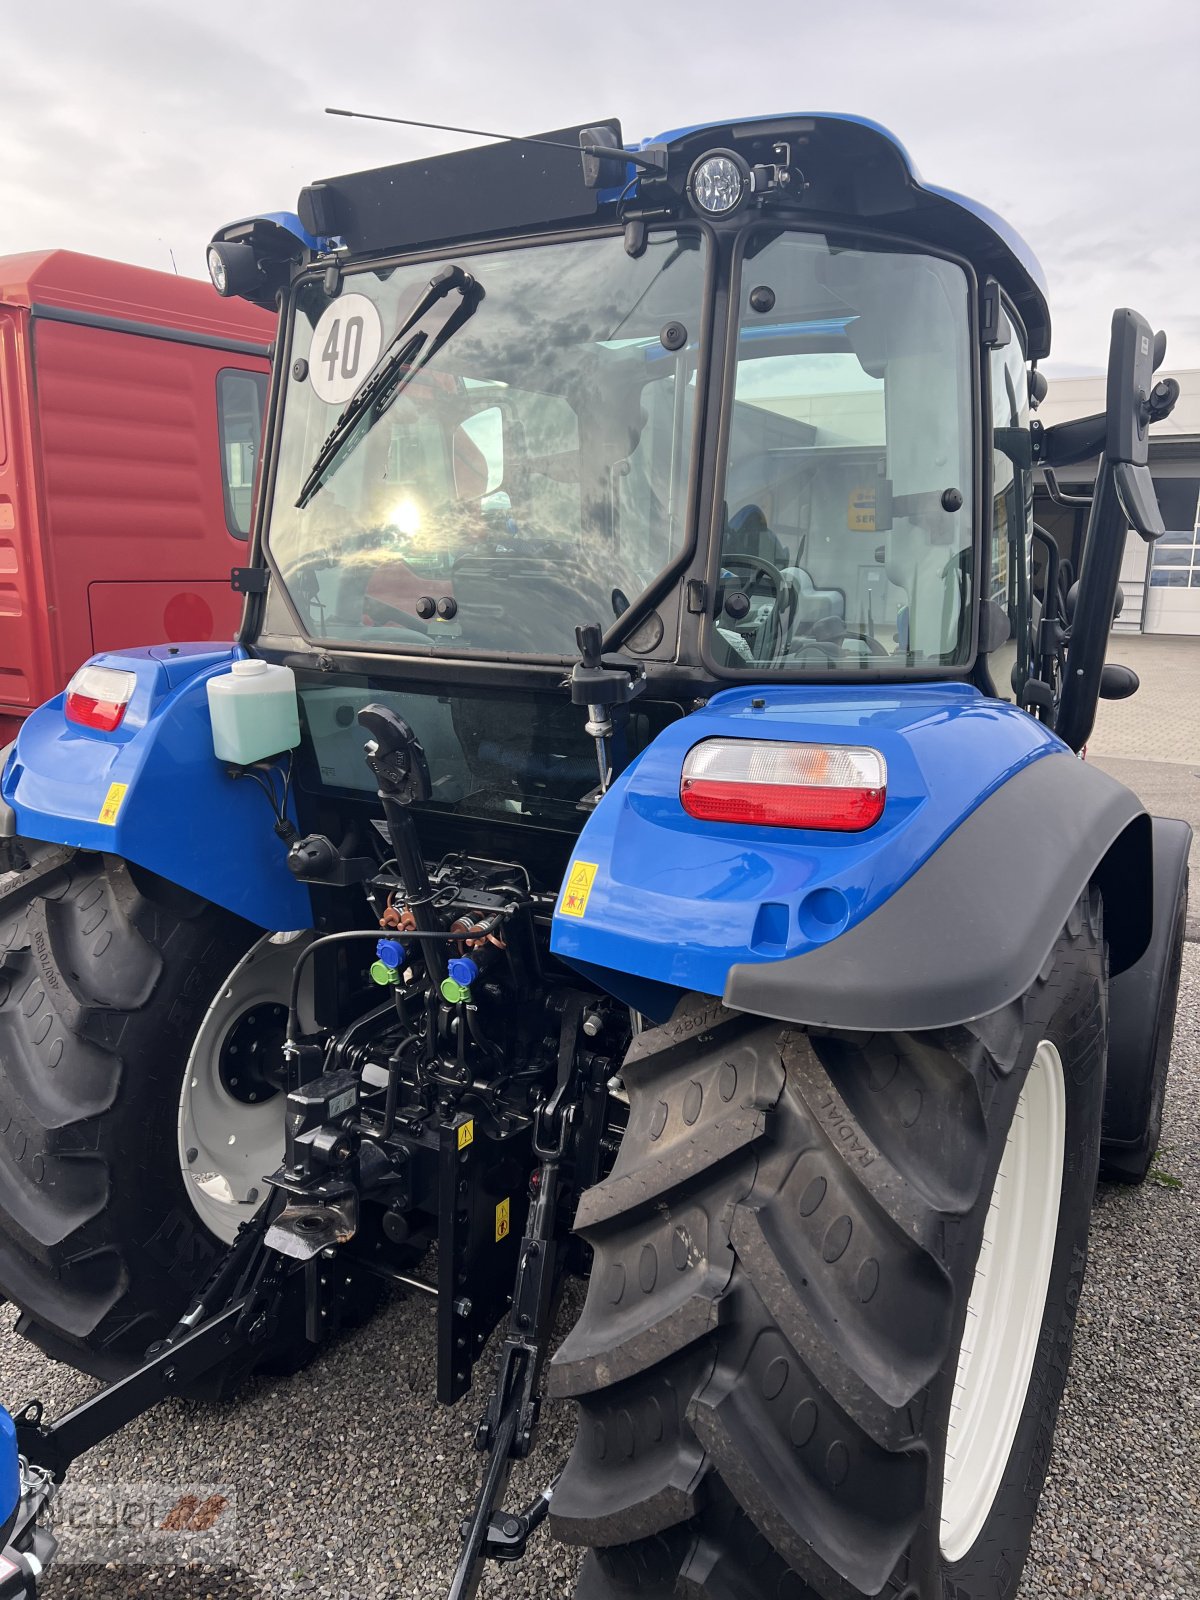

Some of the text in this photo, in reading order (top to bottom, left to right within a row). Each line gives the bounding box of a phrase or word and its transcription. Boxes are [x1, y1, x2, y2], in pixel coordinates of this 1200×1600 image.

[322, 316, 364, 381] 40
[0, 875, 28, 894] DIAL
[821, 1094, 875, 1168] RADIAL
